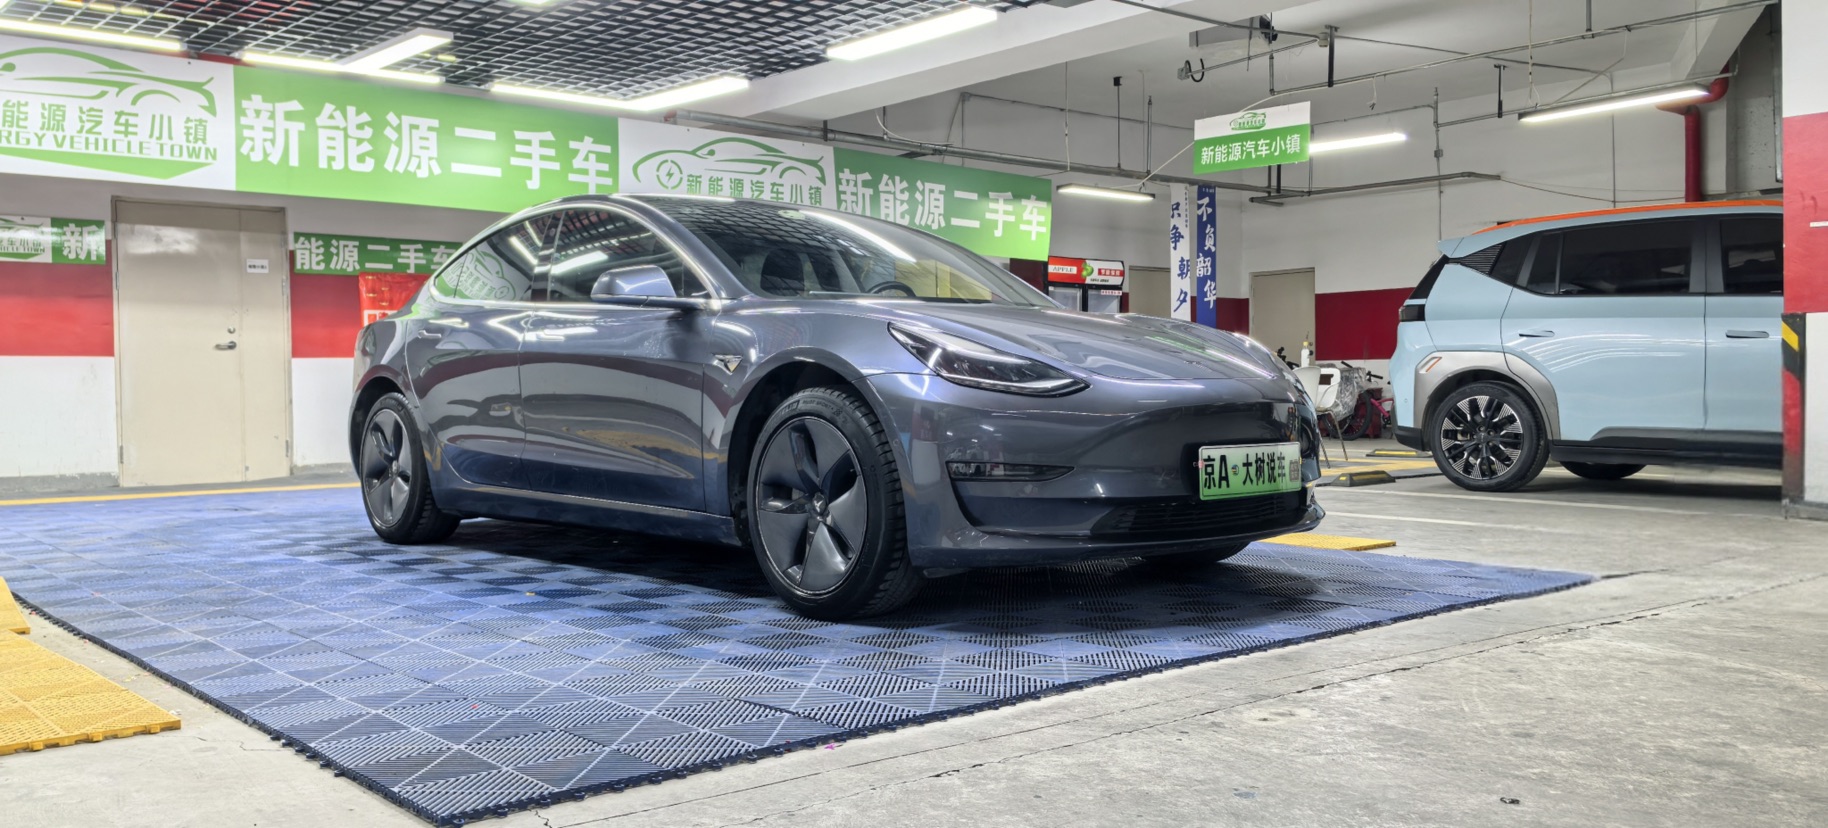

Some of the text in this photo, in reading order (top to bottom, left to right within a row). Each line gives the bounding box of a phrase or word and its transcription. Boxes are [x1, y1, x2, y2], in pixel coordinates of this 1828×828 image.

[2, 99, 208, 145] 能源汽车小镇
[53, 134, 151, 155] VEHICLE
[156, 143, 218, 161] TOWN
[240, 94, 612, 193] 新能源二手车
[1200, 134, 1301, 165] 新能源汽车小镇
[687, 174, 822, 206] 新能源汽车小镇
[838, 168, 1048, 241] 新能源二手车
[62, 223, 101, 261] 新
[294, 237, 457, 274] 能源二手车
[1170, 201, 1190, 313] 只争朝夕
[1197, 197, 1217, 309] 不负韶华
